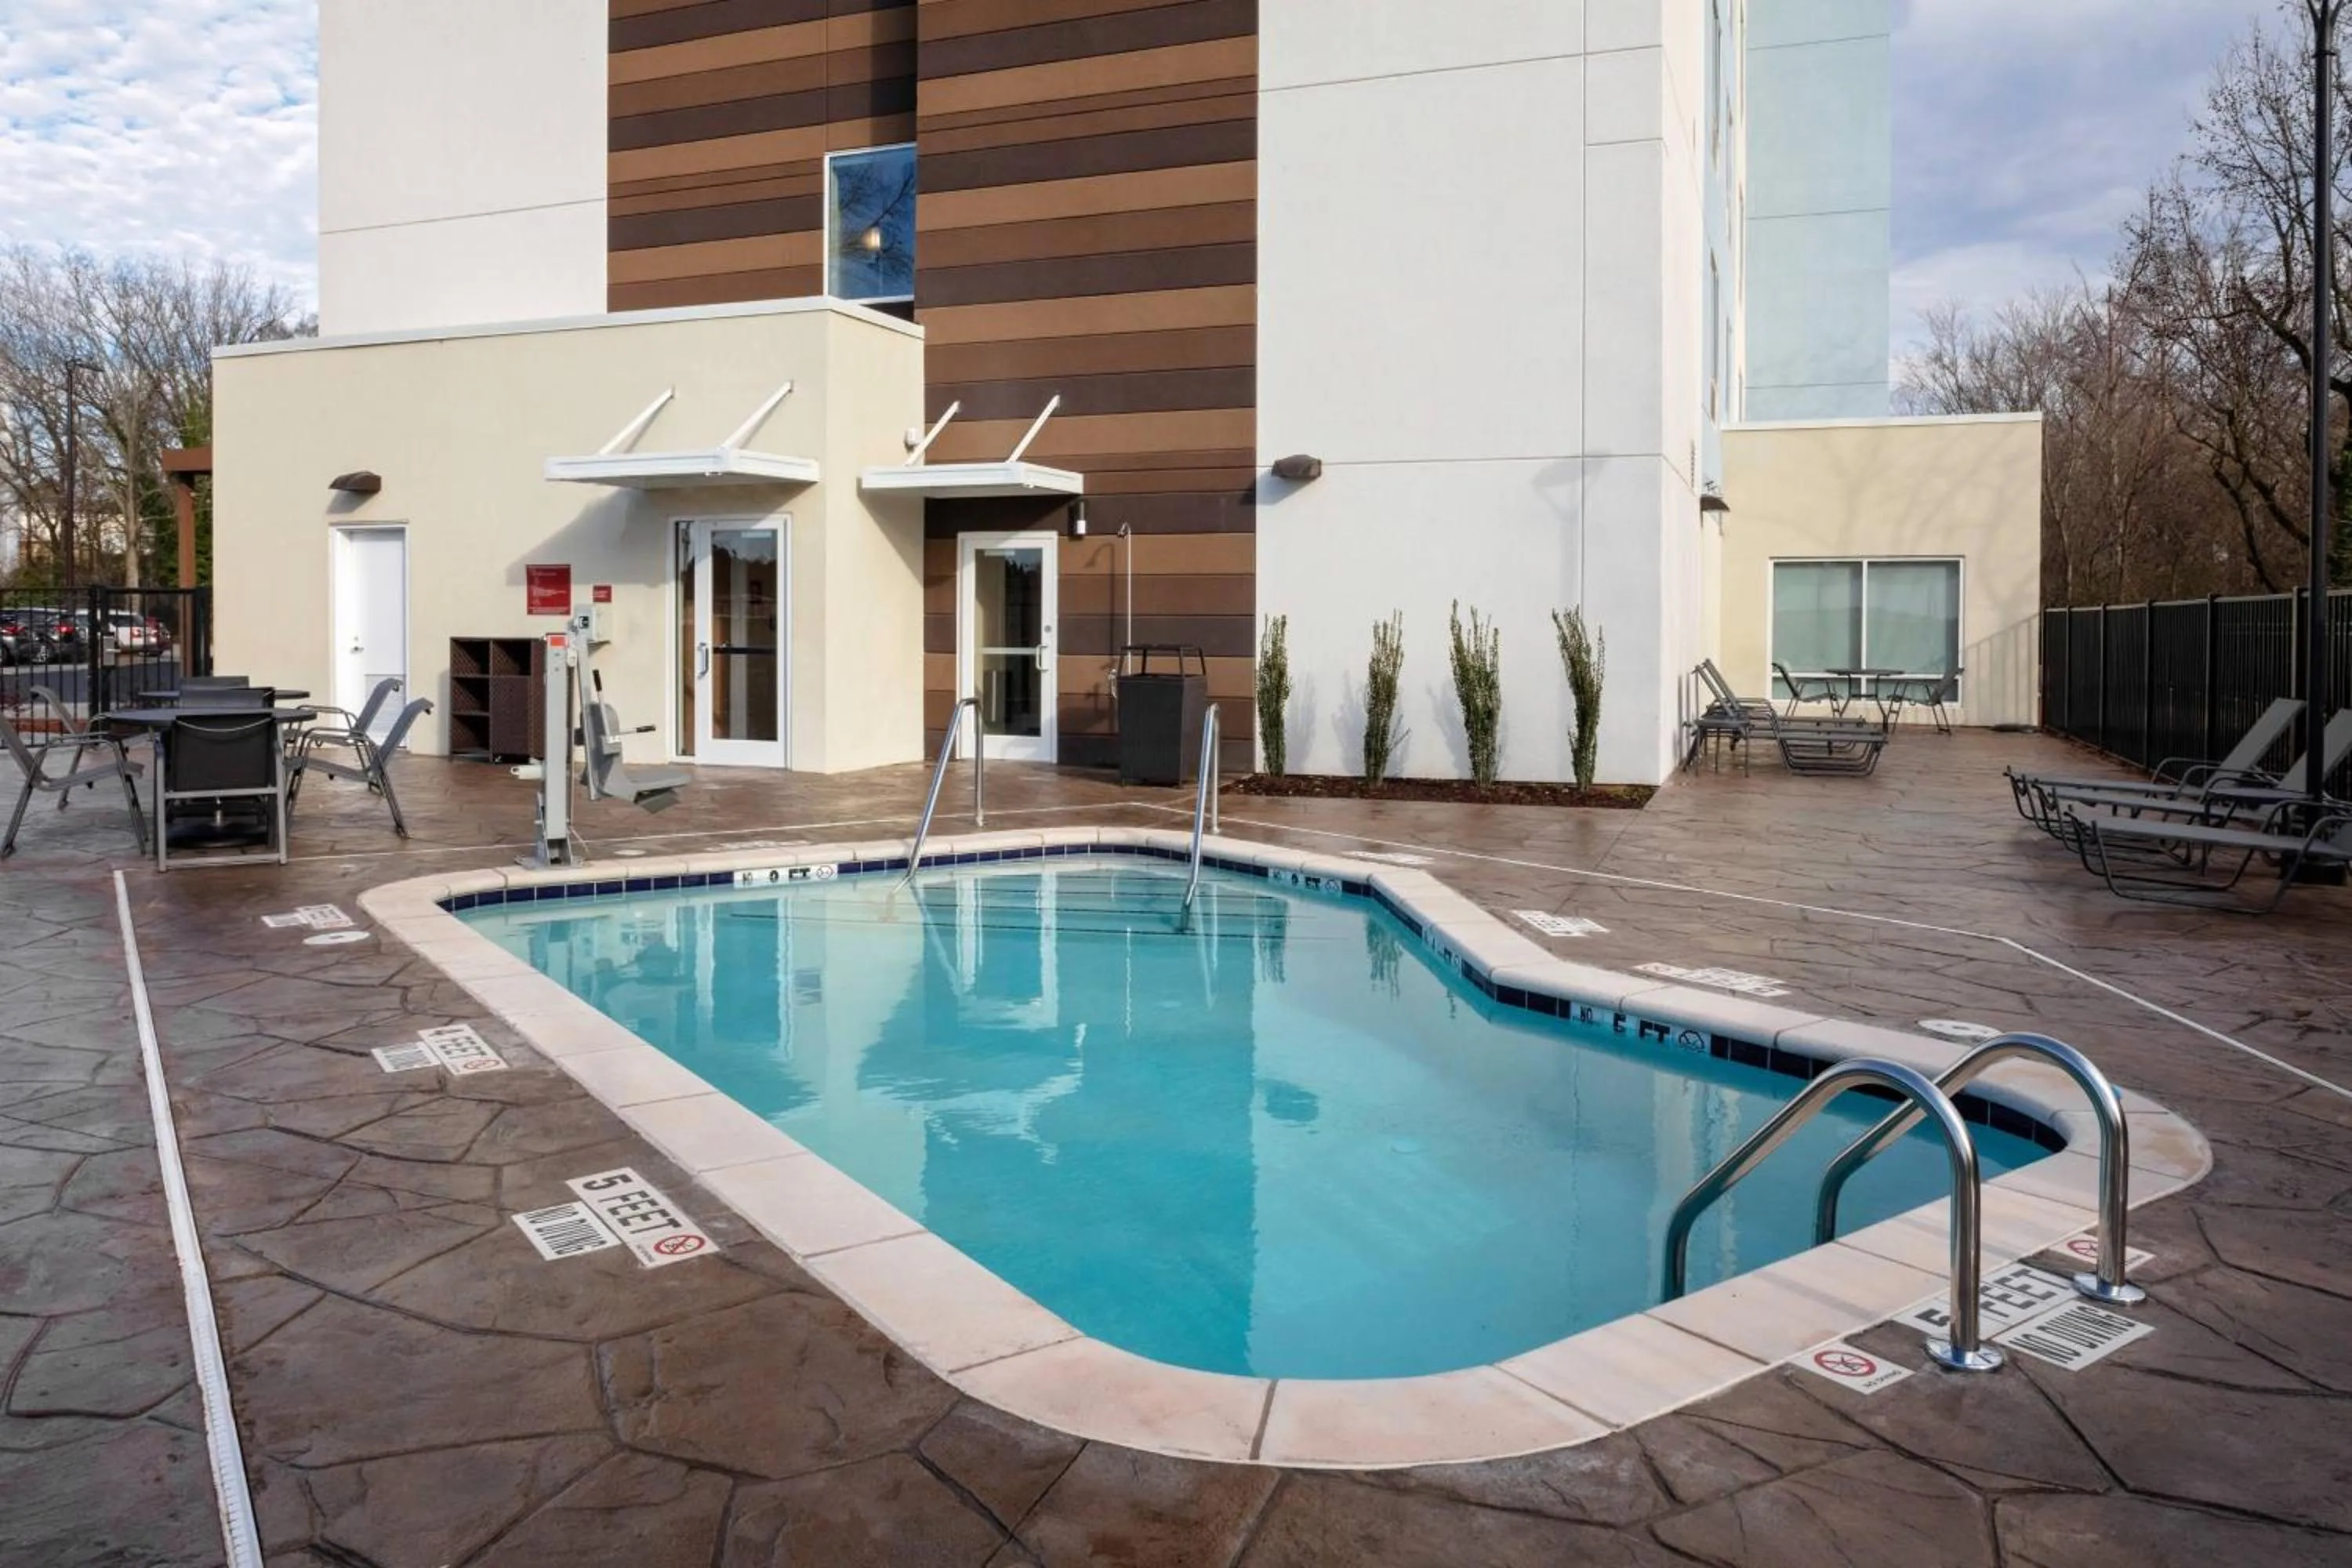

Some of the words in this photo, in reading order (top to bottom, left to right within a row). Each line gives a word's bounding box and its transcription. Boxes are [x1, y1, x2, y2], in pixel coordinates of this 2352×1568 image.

[583, 1174, 633, 1192] 5
[597, 1189, 682, 1235] FEET
[1979, 1268, 2070, 1319] FEET
[2007, 1333, 2083, 1364] NO
[2036, 1305, 2137, 1349] DIVING
